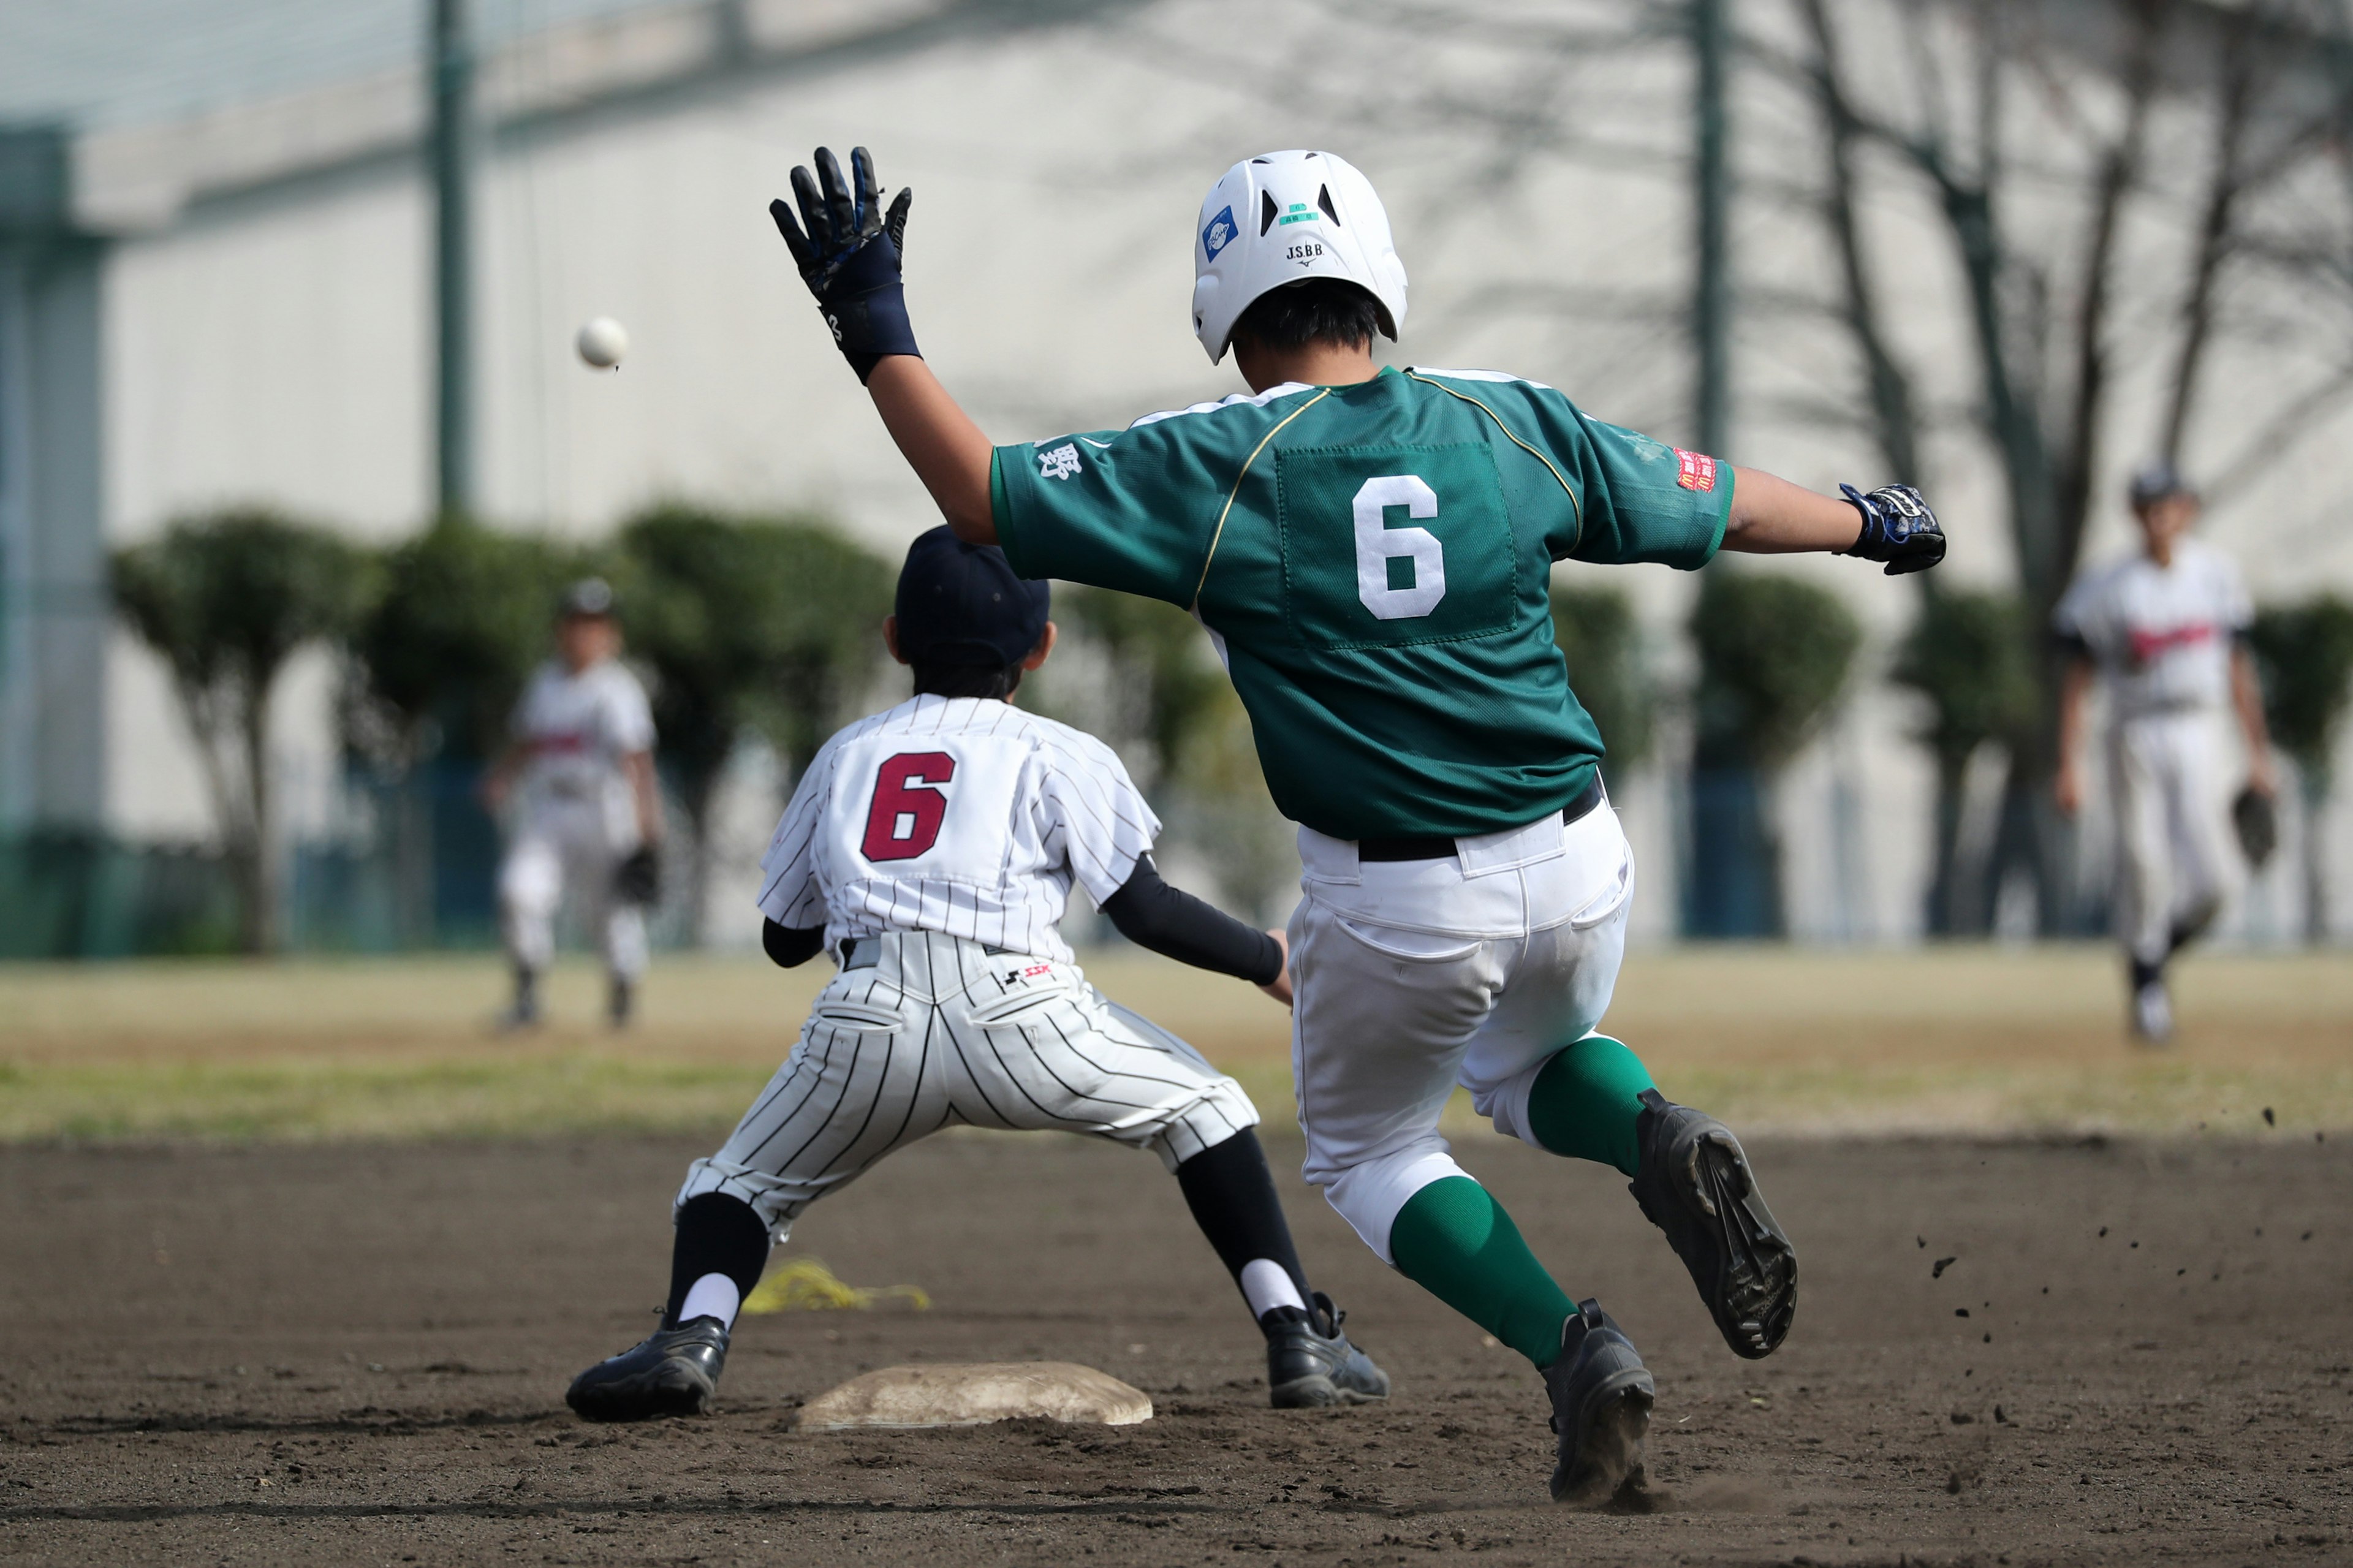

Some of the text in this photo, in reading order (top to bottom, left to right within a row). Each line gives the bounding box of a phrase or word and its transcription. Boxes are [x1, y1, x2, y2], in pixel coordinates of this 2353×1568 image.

[1286, 244, 1325, 260] J.S.B.B.
[1038, 442, 1082, 480] 野
[1353, 475, 1446, 620] 6
[860, 751, 956, 863] 6
[1025, 964, 1051, 978] SSK
